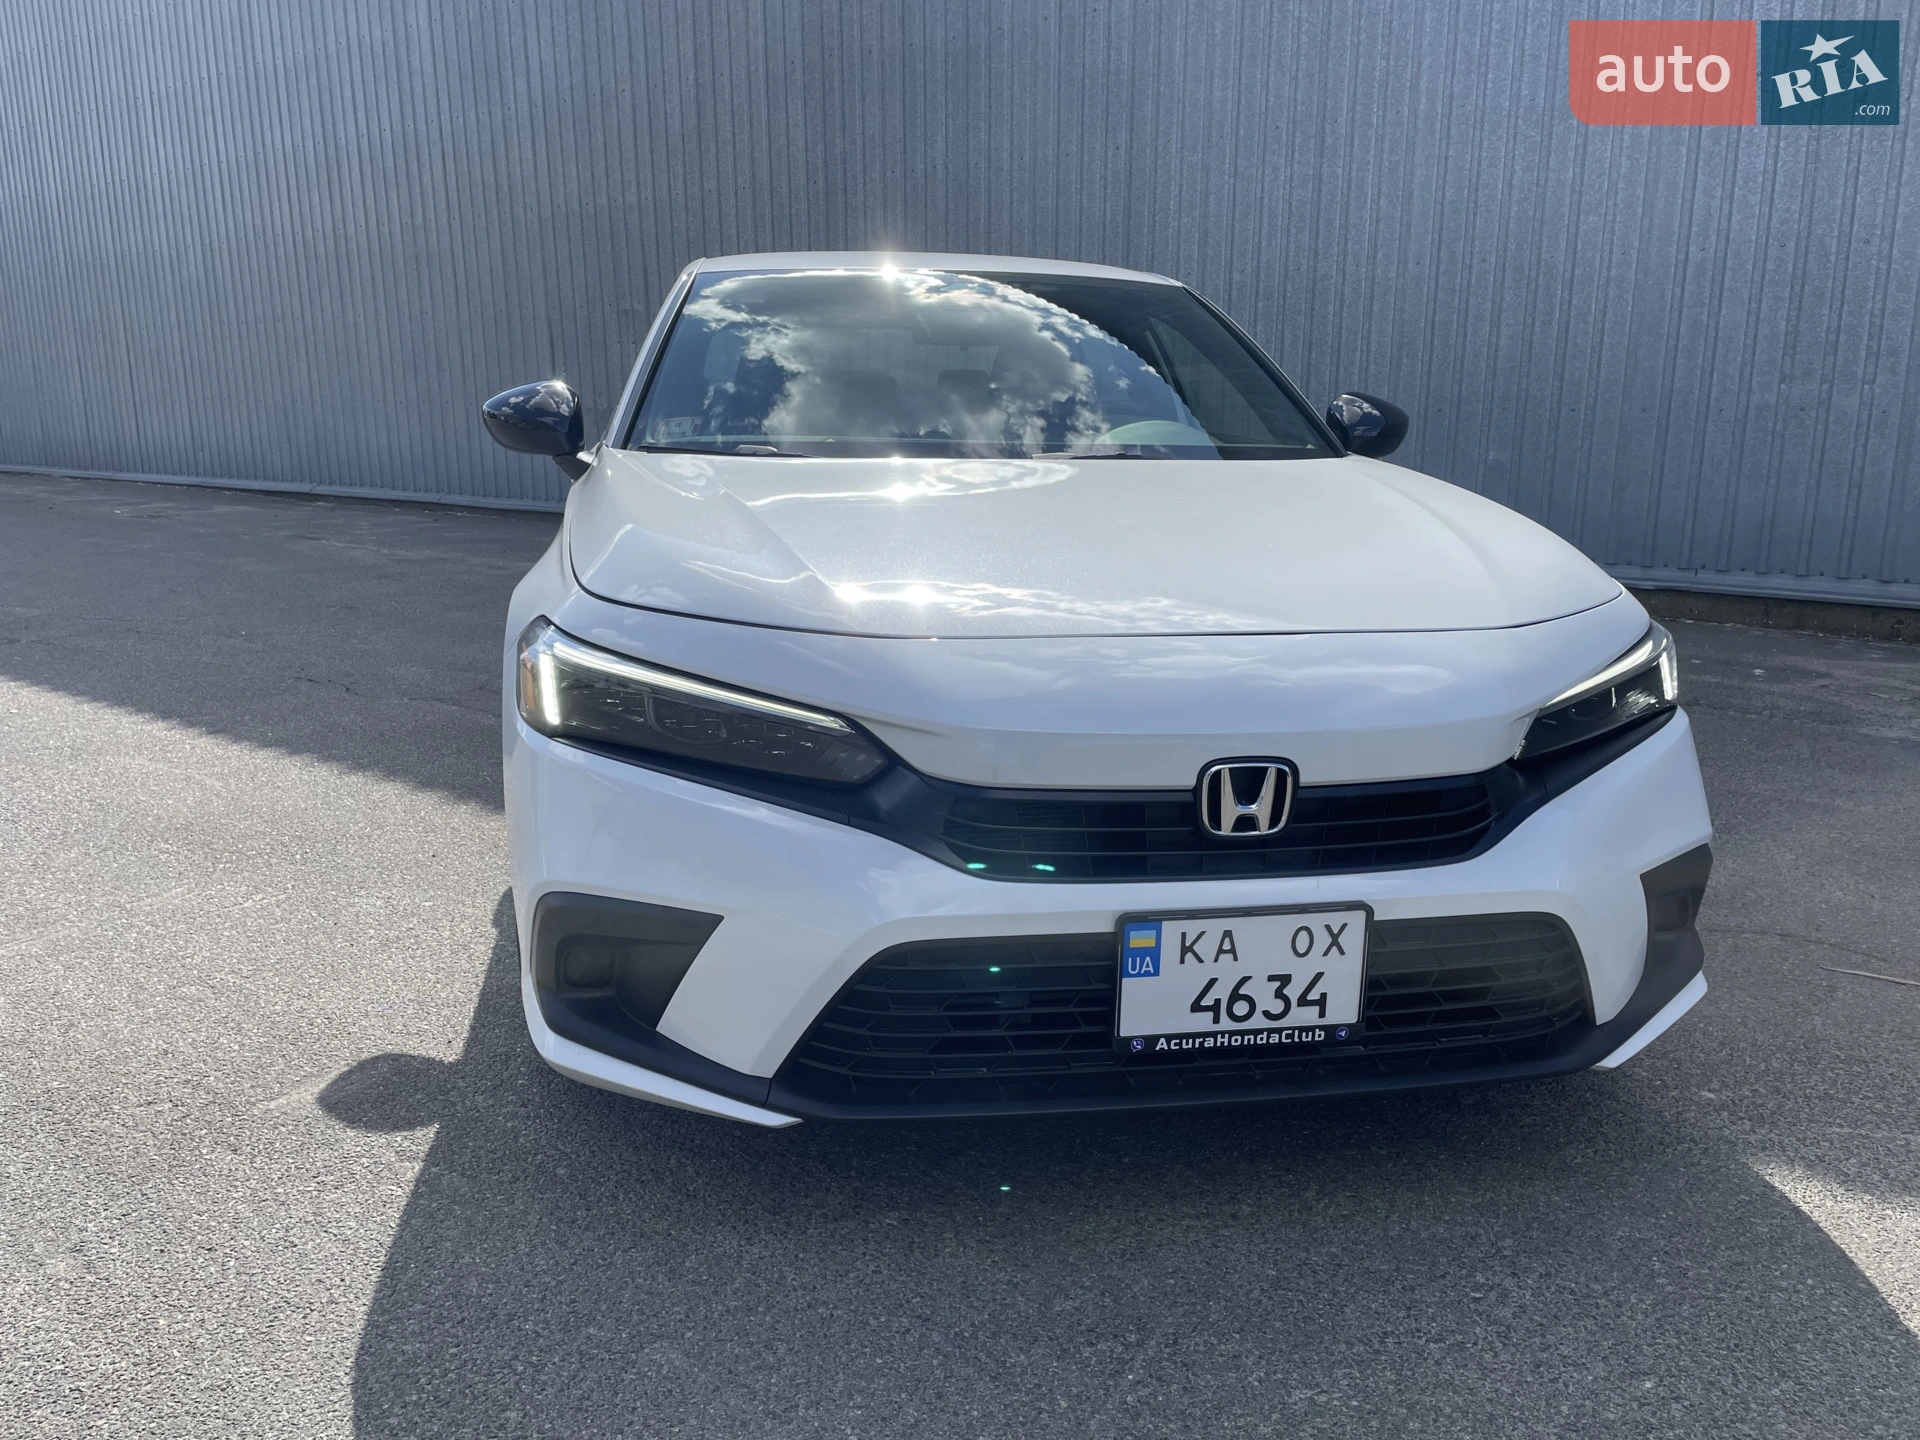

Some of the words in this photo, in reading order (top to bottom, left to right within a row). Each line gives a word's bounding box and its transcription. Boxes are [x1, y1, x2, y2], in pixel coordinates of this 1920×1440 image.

[1179, 930, 1239, 965] KA
[1291, 922, 1348, 958] OX
[1127, 956, 1154, 975] UA
[1190, 971, 1328, 1025] 4634
[1155, 1028, 1326, 1051] AcuraHondaClub
